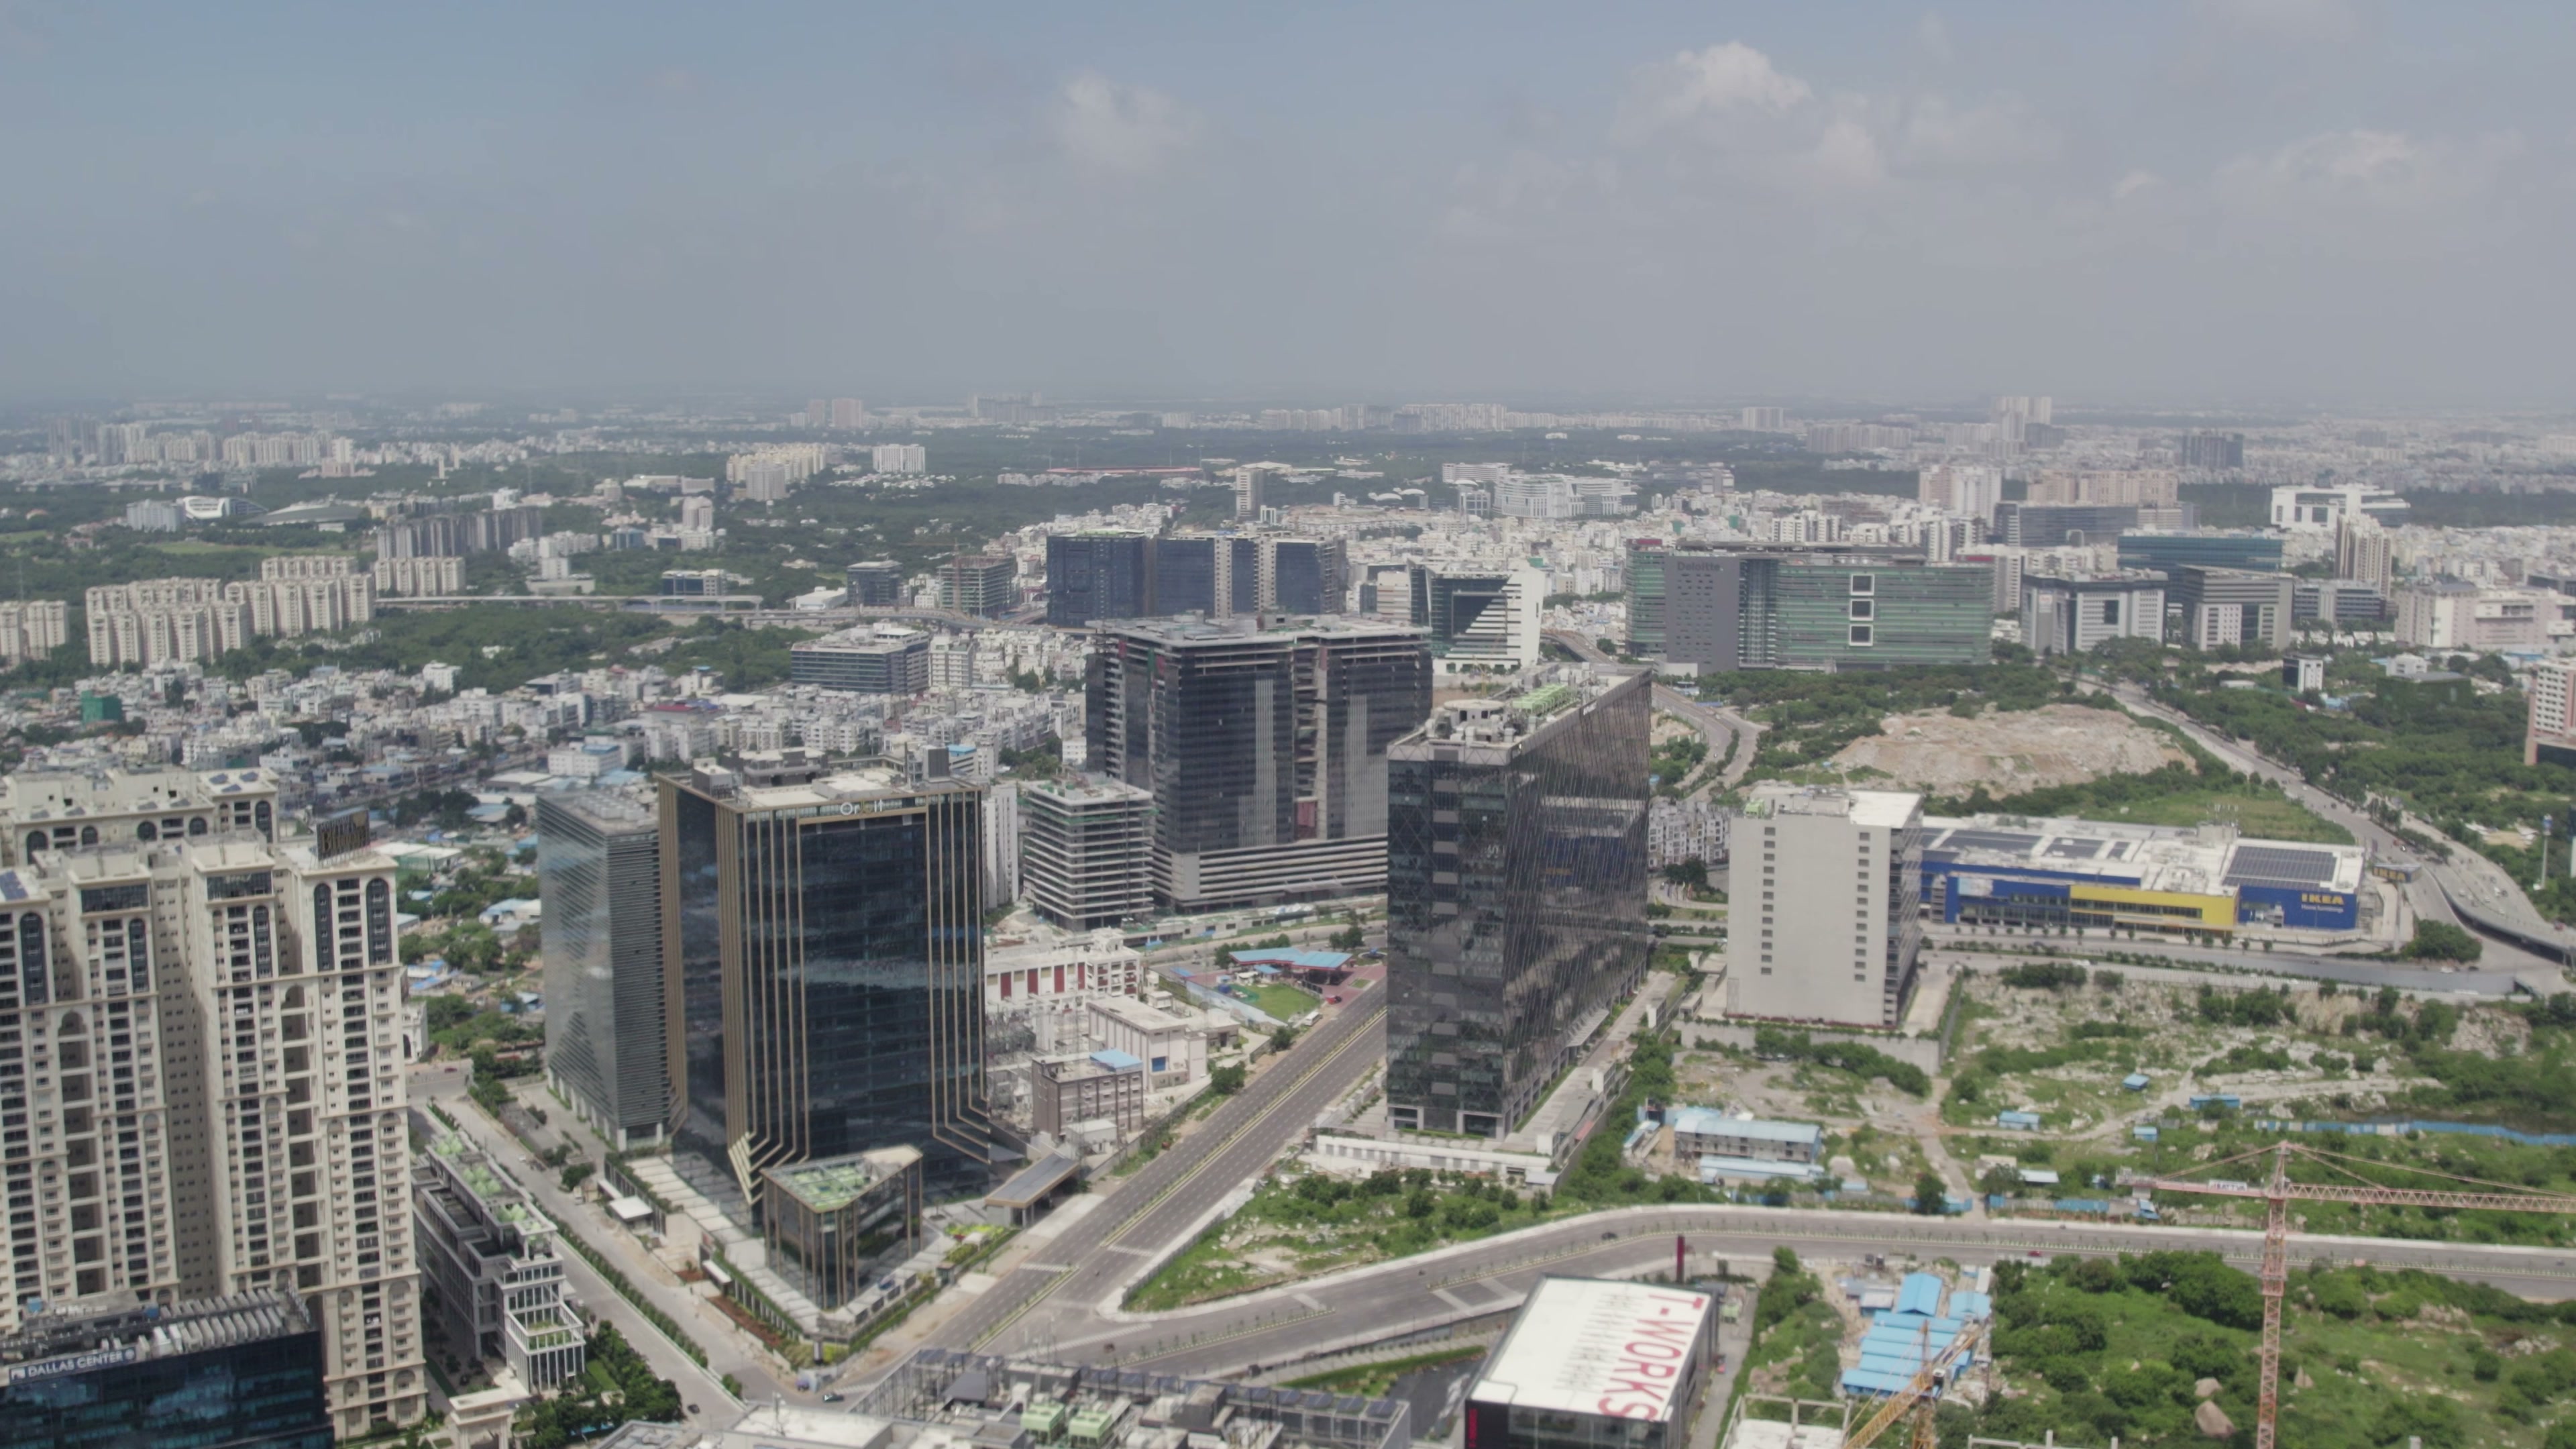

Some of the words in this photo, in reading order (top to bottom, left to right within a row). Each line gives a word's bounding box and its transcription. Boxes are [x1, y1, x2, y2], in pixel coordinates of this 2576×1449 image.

[2373, 867, 2406, 881] IKEA
[2302, 894, 2344, 905] IKEA
[28, 1360, 74, 1377] DALLAS
[77, 1350, 123, 1368] CENTER
[1598, 1295, 1705, 1422] T-WORKS
